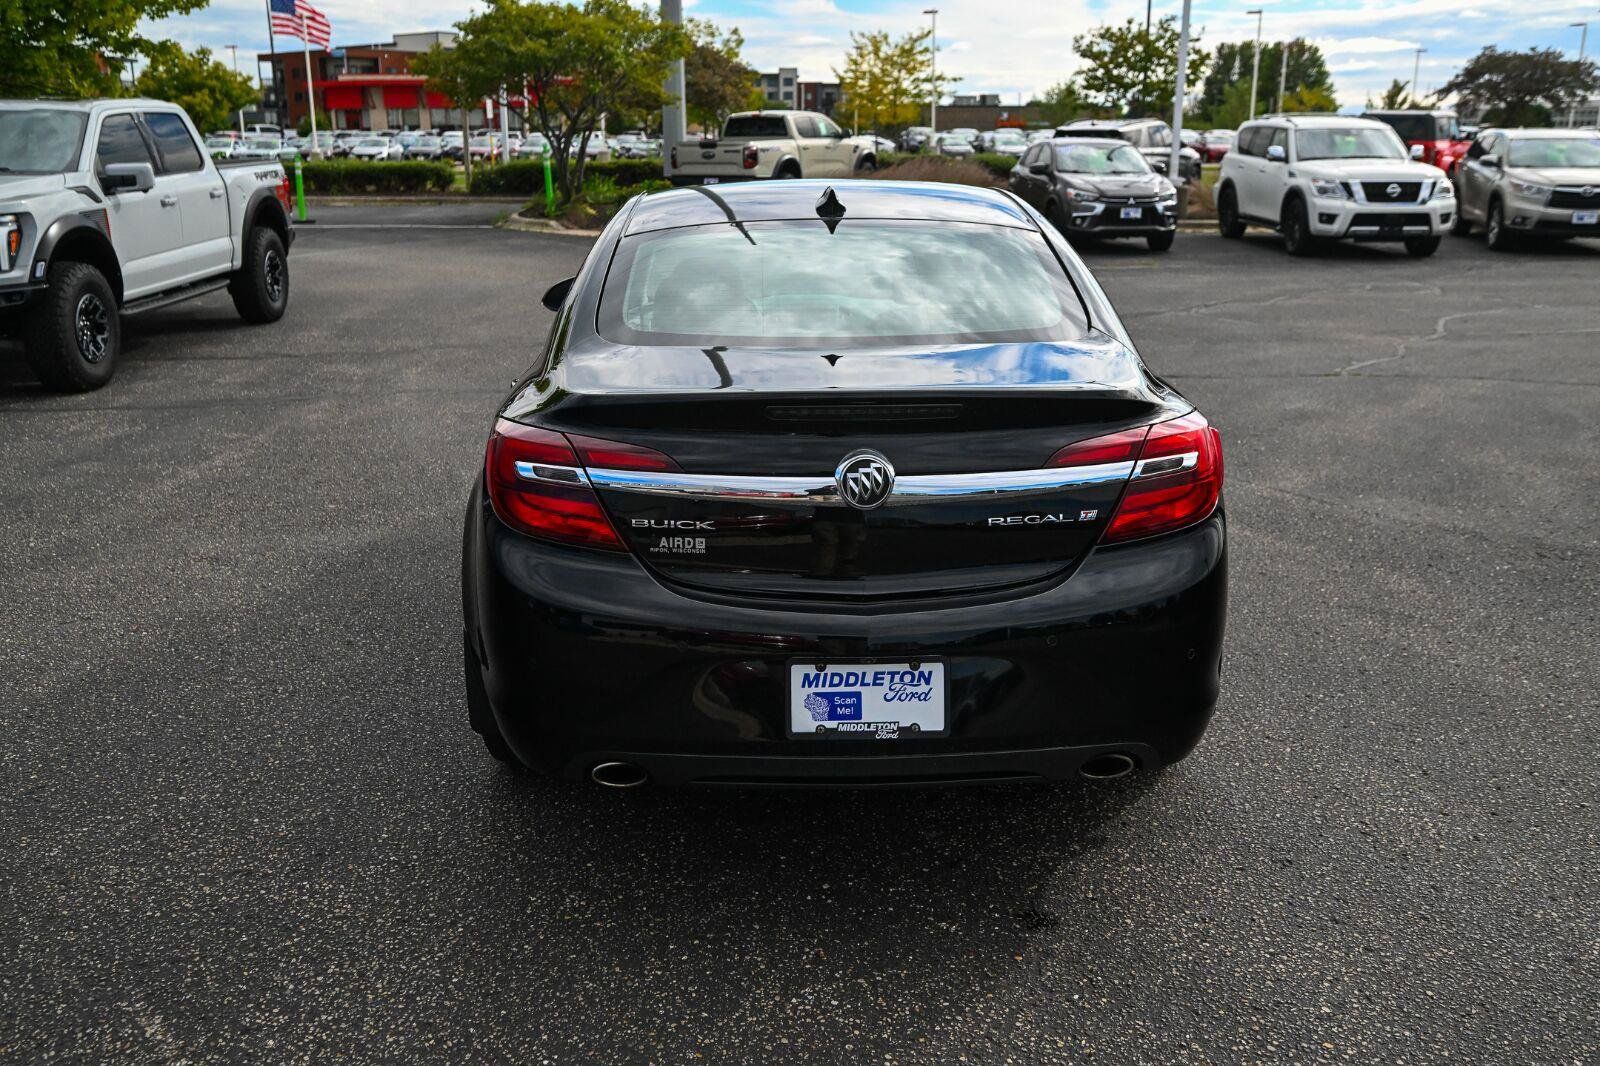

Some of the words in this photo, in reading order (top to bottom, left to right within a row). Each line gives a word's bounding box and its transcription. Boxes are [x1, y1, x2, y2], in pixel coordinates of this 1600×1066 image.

[254, 170, 279, 181] RAPTOR
[631, 519, 716, 530] BUICK
[987, 513, 1074, 526] REGAL
[659, 536, 694, 549] AIRD
[801, 670, 933, 689] MIDDLETON
[883, 682, 933, 703] Ford
[834, 696, 857, 705] Scan
[837, 706, 854, 715] Me!
[838, 722, 899, 732] MIDDLETON
[875, 729, 899, 739] Ford
